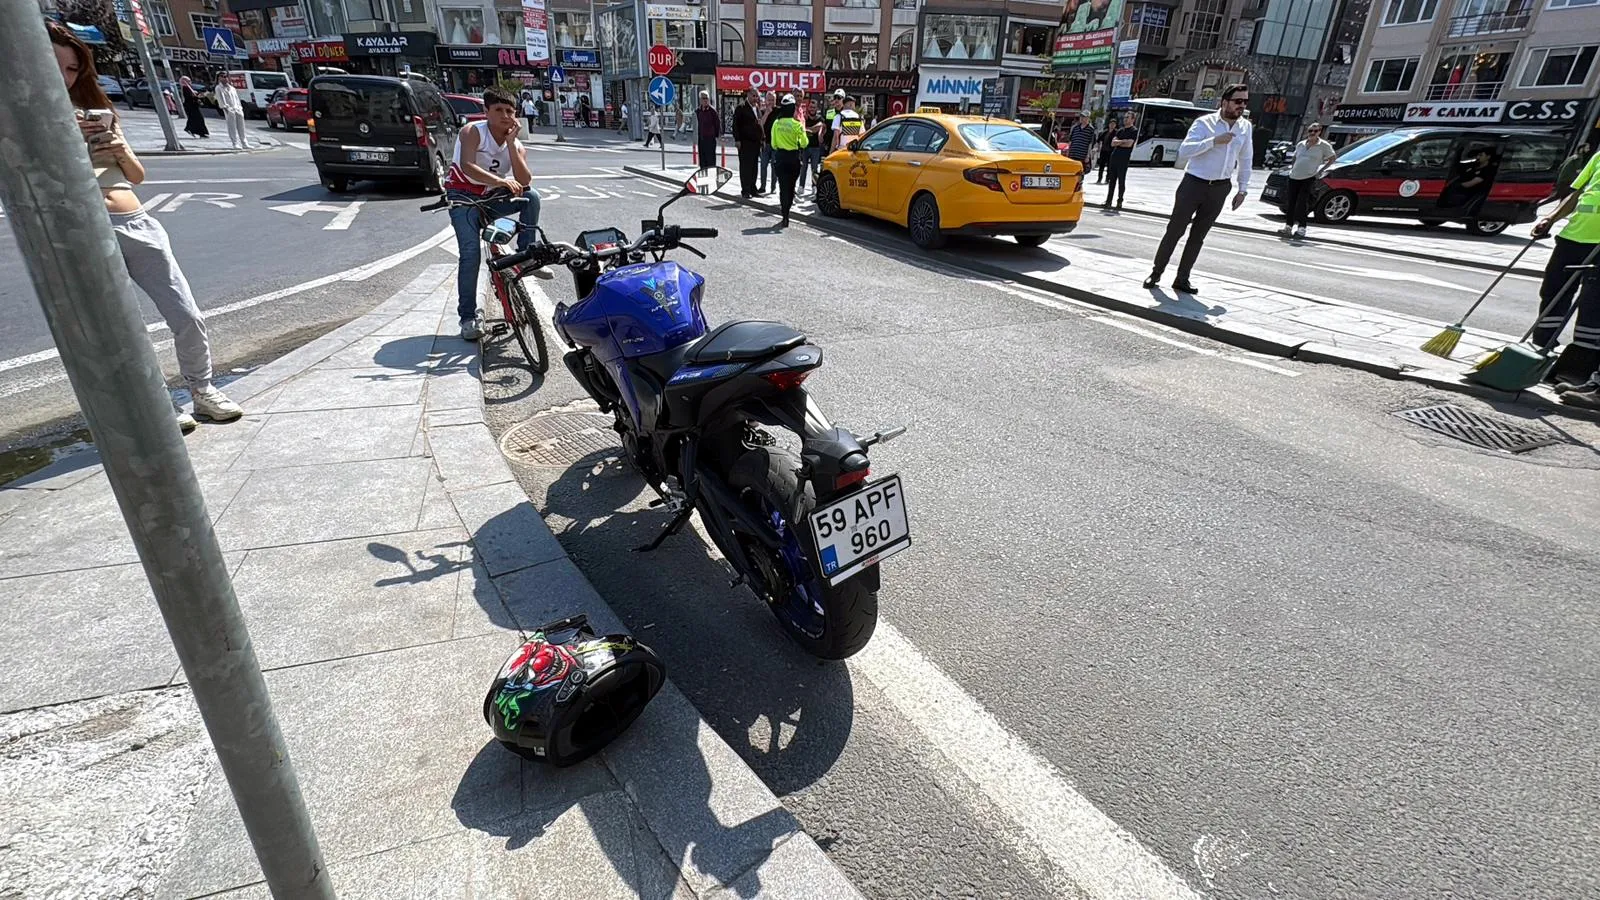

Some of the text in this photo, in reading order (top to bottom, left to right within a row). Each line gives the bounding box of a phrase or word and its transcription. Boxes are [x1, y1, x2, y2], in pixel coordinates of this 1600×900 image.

[357, 36, 408, 47] KAYALAR
[650, 52, 671, 66] DUR
[749, 71, 820, 89] OUTLET
[1437, 106, 1500, 118] CANKAT
[489, 159, 500, 173] 2
[1025, 177, 1033, 186] 59
[816, 482, 896, 538] 59 APF
[851, 520, 891, 555] 960
[826, 560, 837, 571] TR
